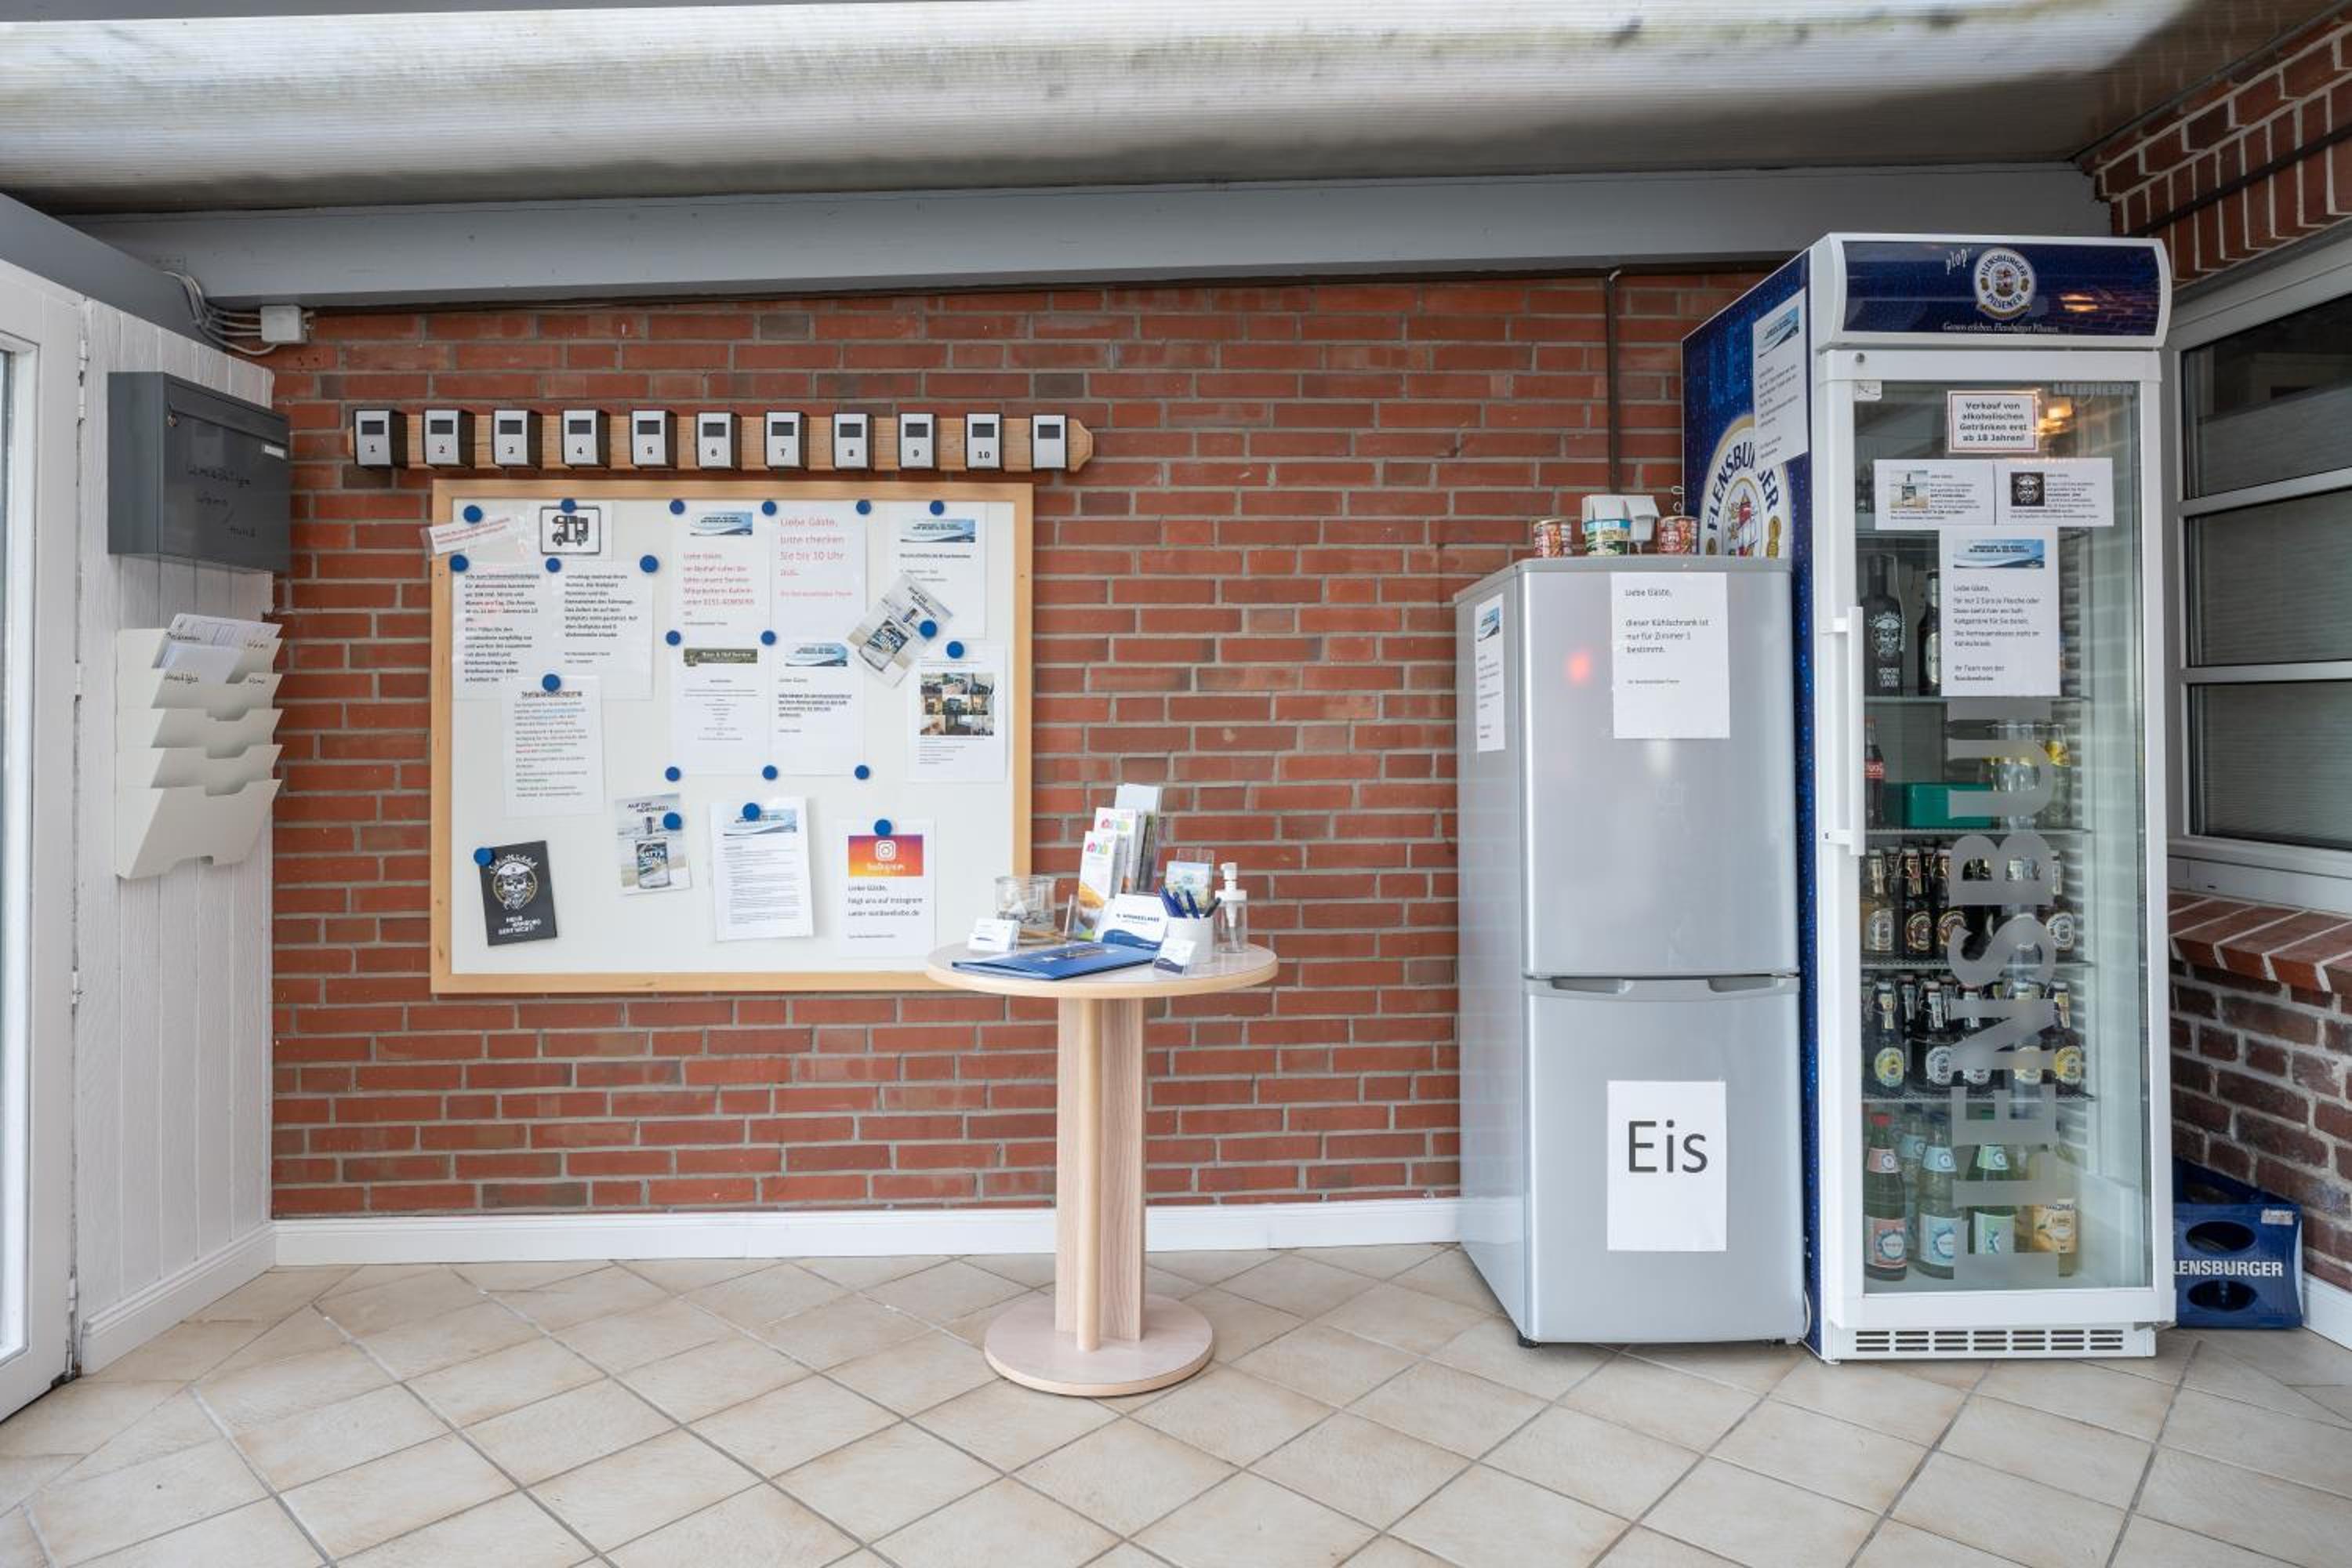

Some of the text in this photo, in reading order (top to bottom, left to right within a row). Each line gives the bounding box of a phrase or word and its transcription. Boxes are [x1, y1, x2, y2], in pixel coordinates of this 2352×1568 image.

[1981, 254, 2028, 277] FLENSBURGER
[1986, 292, 2024, 310] PILSENER
[1965, 401, 2020, 410] Verkauf von
[1959, 423, 2027, 431] Getränken erst
[1962, 434, 2025, 442] ab 18 Jahren!
[438, 445, 446, 453] 2
[507, 445, 514, 454] 3
[576, 446, 583, 455] 4
[647, 446, 653, 455] 5
[711, 448, 717, 457] 6
[780, 448, 786, 457] 7
[913, 449, 920, 458] 9
[978, 451, 990, 459] 10
[780, 517, 804, 527] Liebe
[814, 550, 826, 561] 10
[827, 550, 844, 561] Uhr
[1625, 589, 1647, 598] Liebe
[1625, 618, 1710, 628] dieser Kühlschrank ist
[1626, 631, 1640, 641] nur
[1641, 631, 1653, 641] für
[1654, 631, 1684, 641] Zimmer
[1628, 1119, 1708, 1174] Eis
[2173, 1259, 2284, 1277] LENSBURGER
